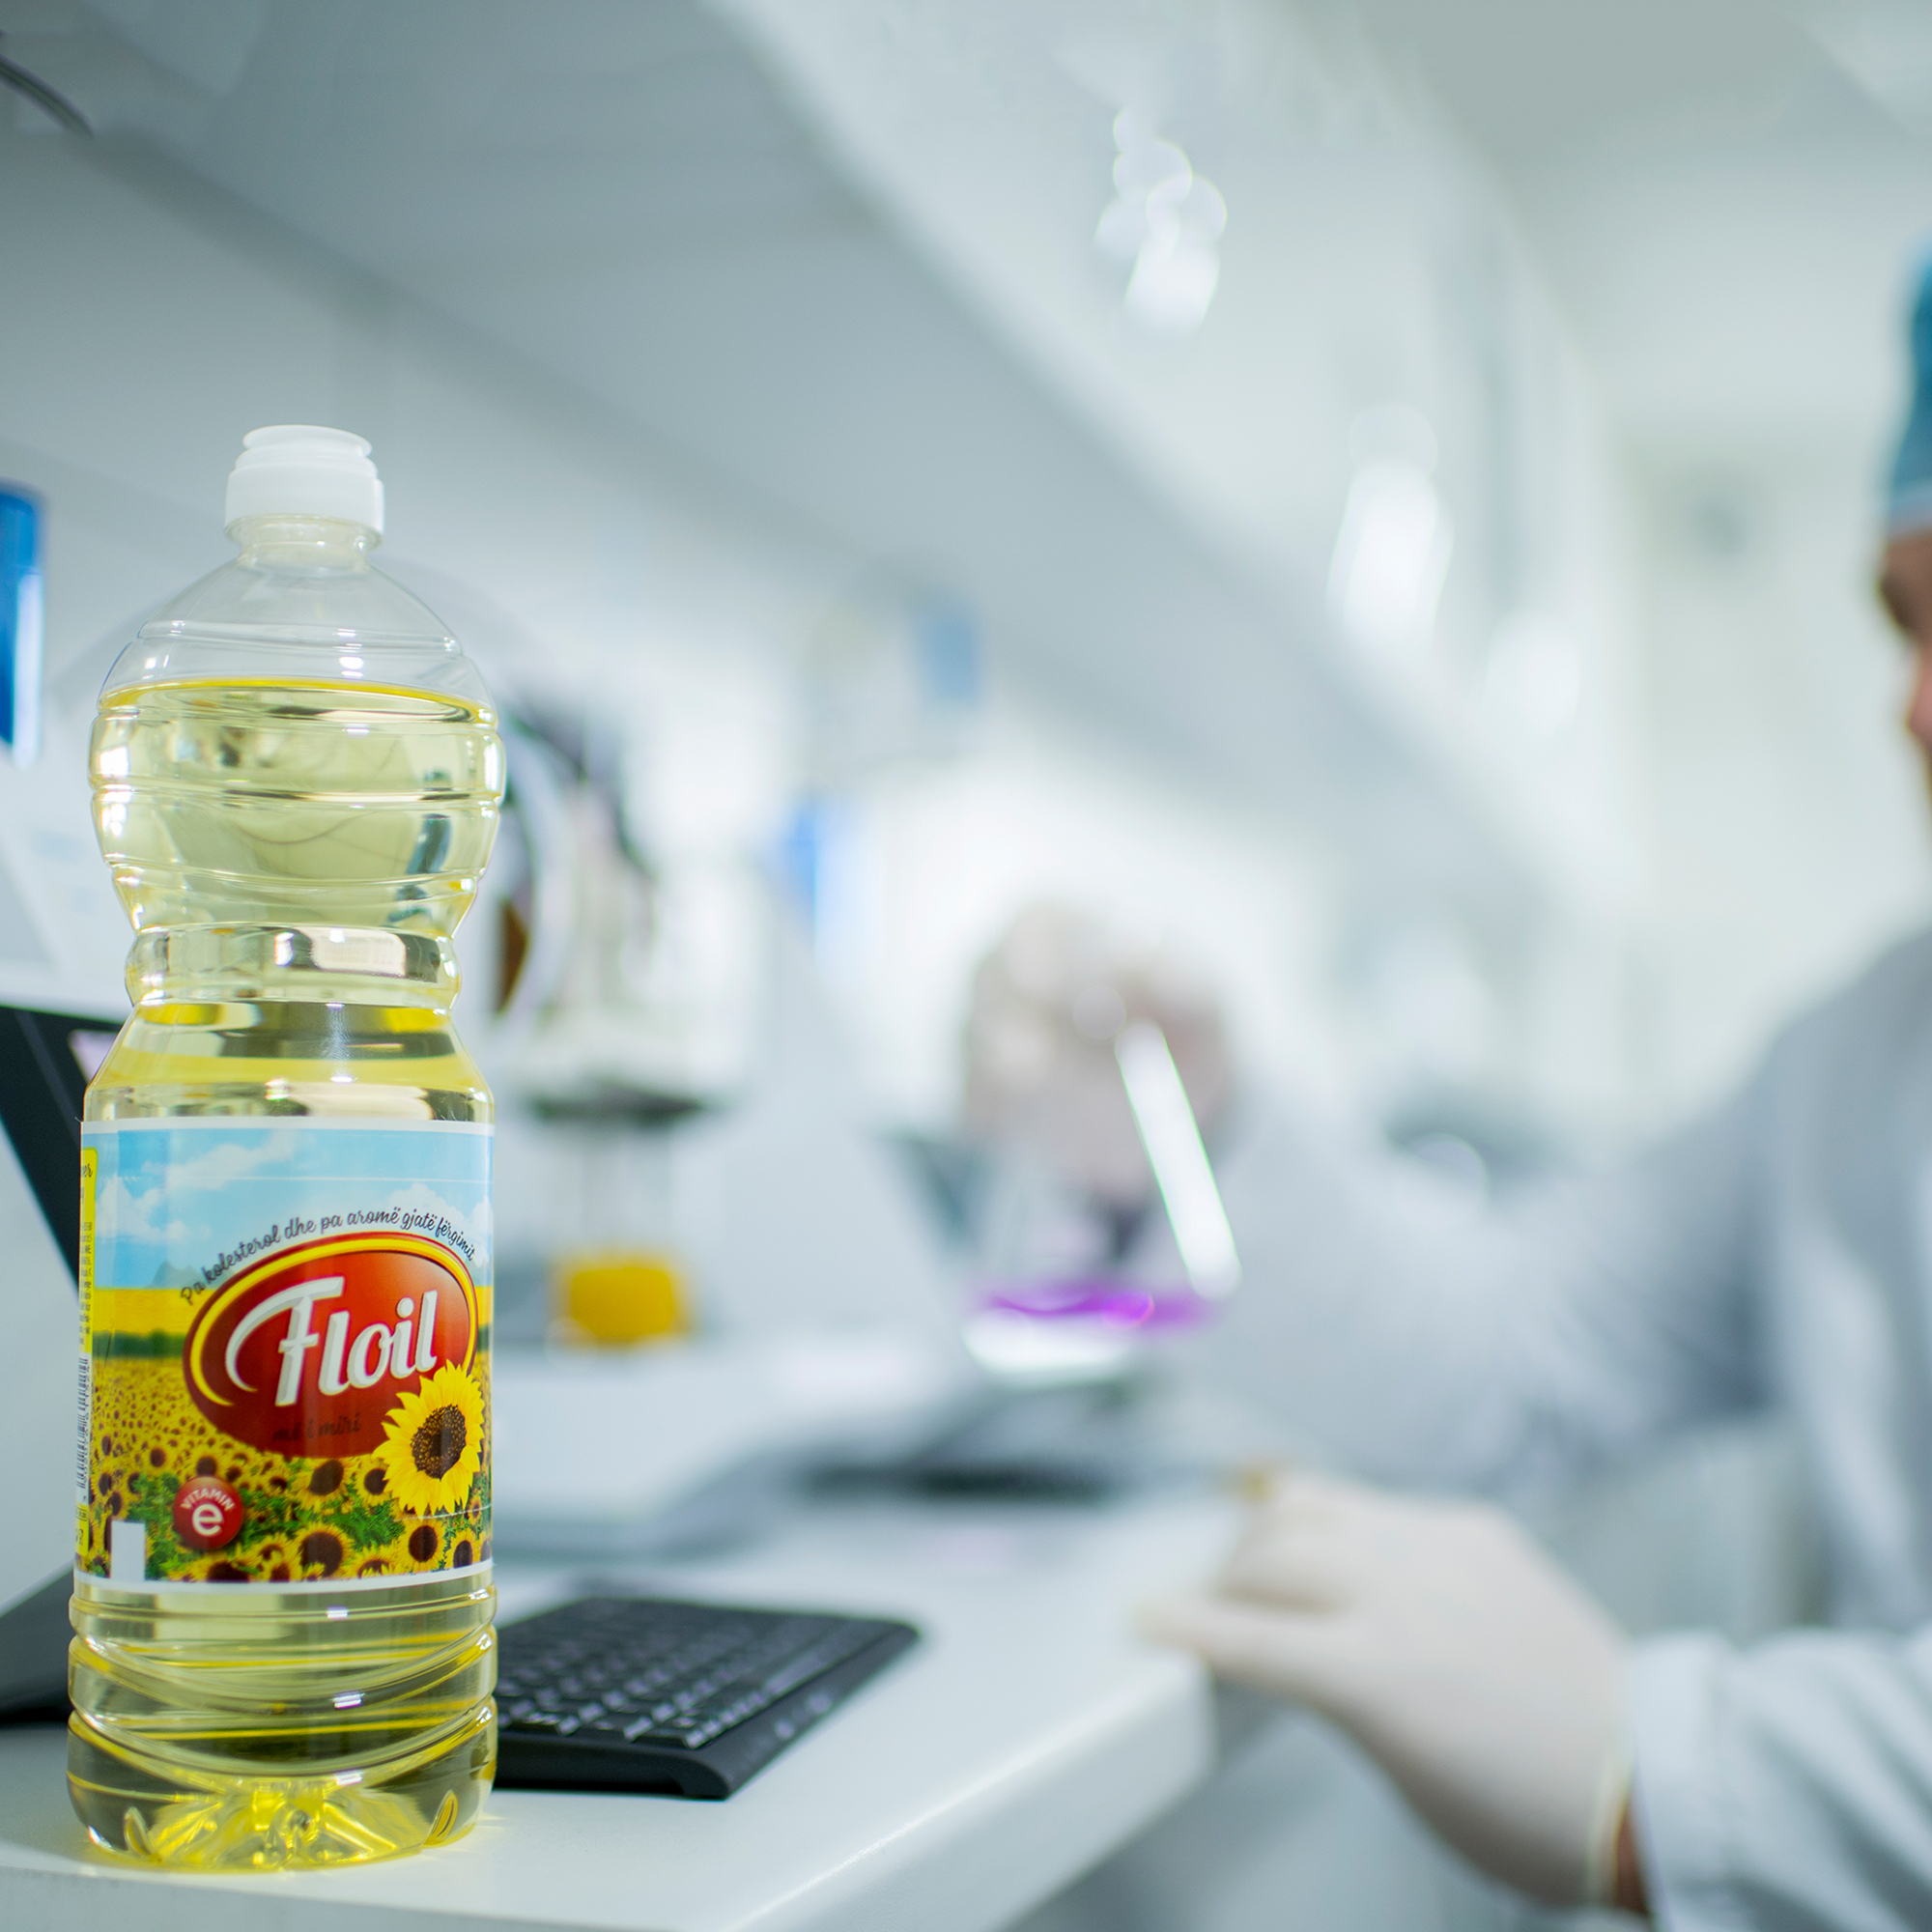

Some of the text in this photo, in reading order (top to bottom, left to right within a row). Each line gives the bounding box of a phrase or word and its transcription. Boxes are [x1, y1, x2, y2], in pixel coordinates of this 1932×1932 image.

[180, 1281, 206, 1306] Pa
[201, 1224, 281, 1284] kolesterol
[284, 1217, 317, 1239] dhe
[320, 1214, 343, 1235] pa
[347, 1207, 400, 1226] aromë
[400, 1208, 438, 1231] gjatë
[225, 1275, 438, 1407] Floil
[180, 1488, 236, 1512] VITAMIN
